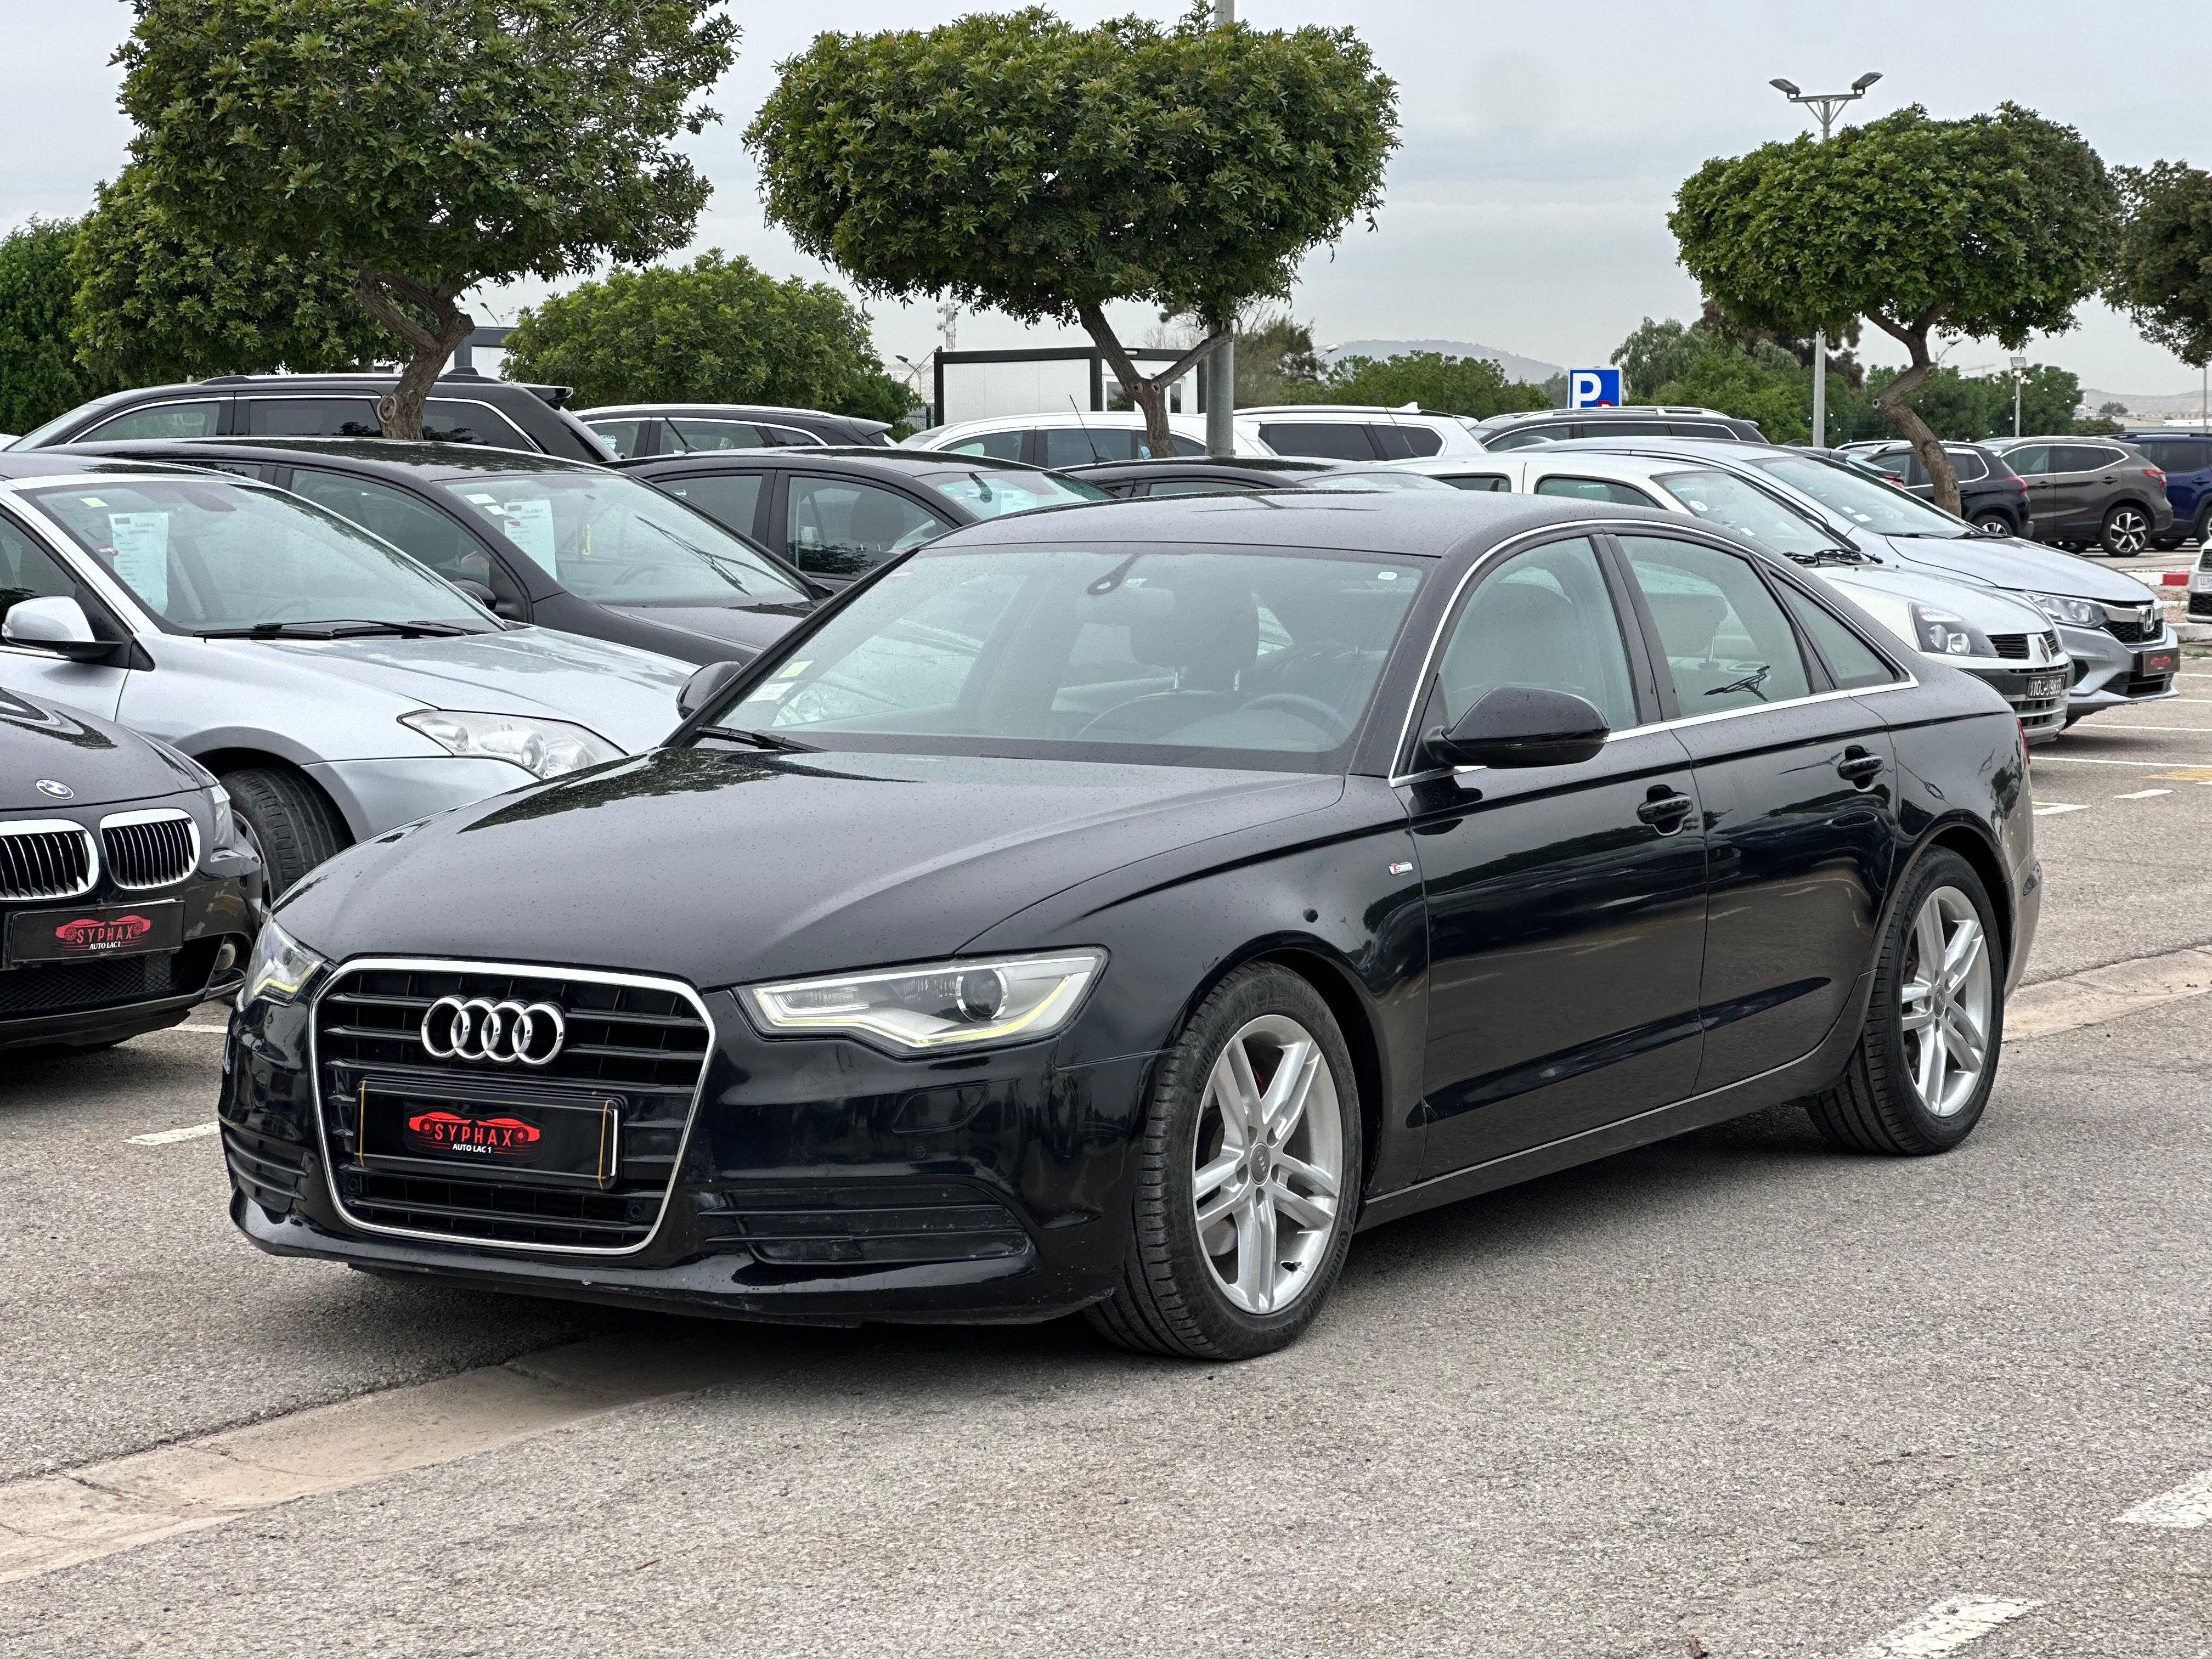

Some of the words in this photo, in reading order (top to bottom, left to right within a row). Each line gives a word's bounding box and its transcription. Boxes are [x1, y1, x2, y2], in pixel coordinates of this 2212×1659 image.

[1572, 373, 1602, 408] P
[76, 924, 133, 944] SYPHAX
[89, 942, 106, 950] AUTO
[435, 1123, 512, 1147] SYPHAX
[452, 1143, 471, 1152] AUTO
[473, 1144, 487, 1153] LAC
[1307, 1228, 1350, 1319] Continental
